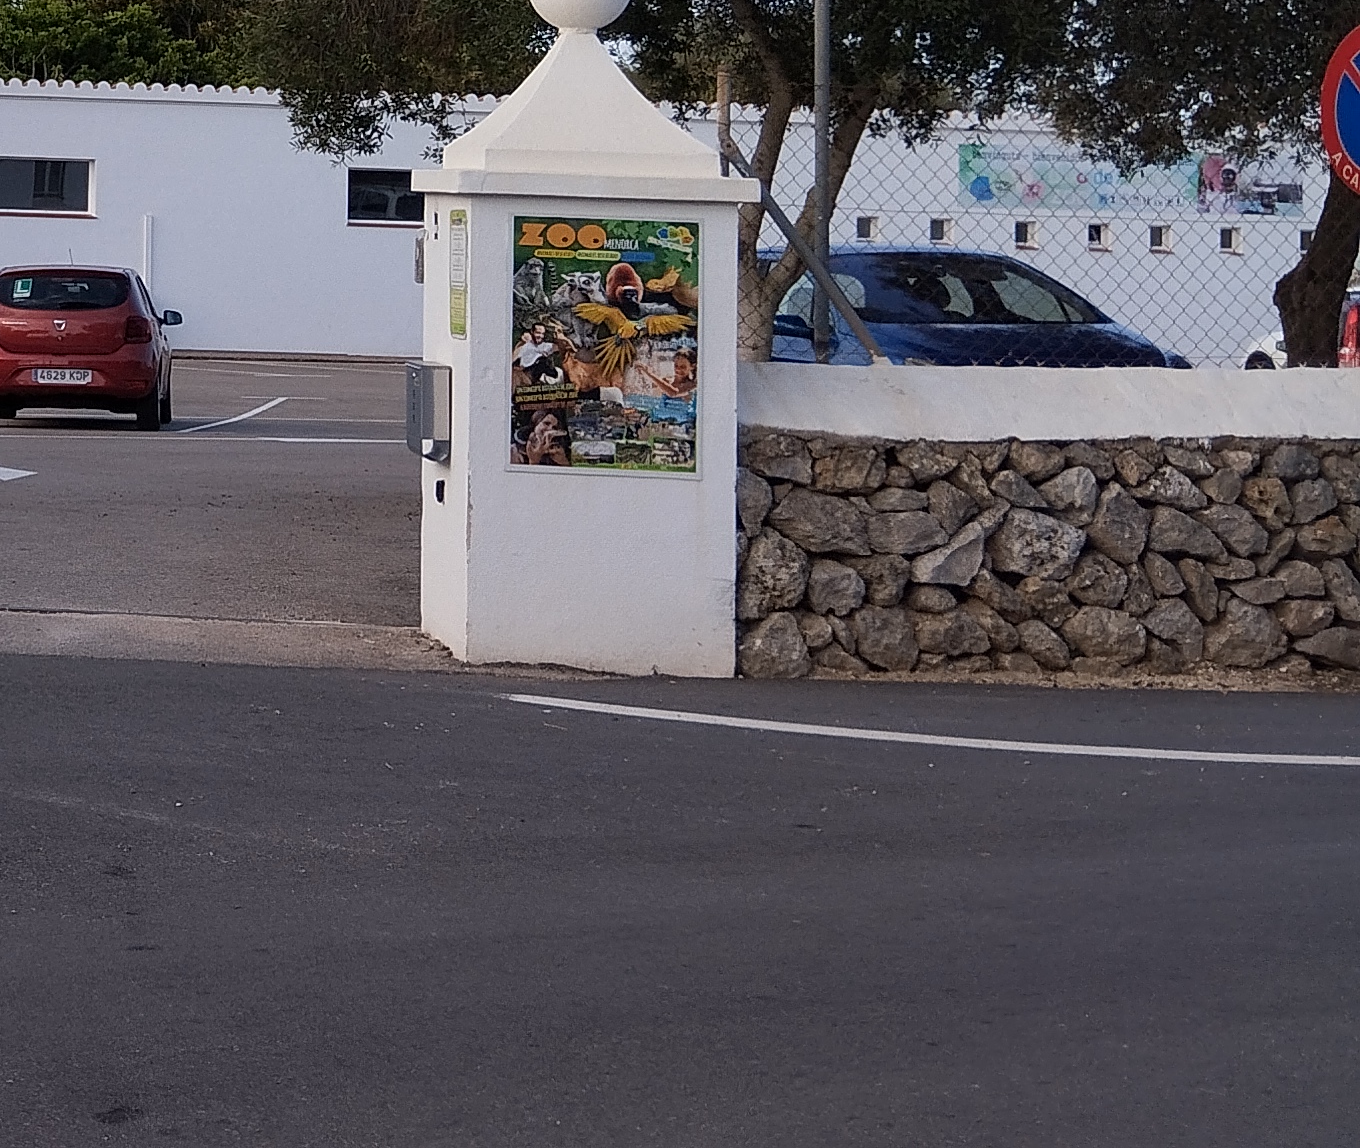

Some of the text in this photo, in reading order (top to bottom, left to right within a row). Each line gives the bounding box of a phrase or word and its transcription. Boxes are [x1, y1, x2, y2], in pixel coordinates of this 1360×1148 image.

[1331, 152, 1360, 190] A CA
[518, 223, 607, 249] ZOO
[40, 370, 67, 381] 4629
